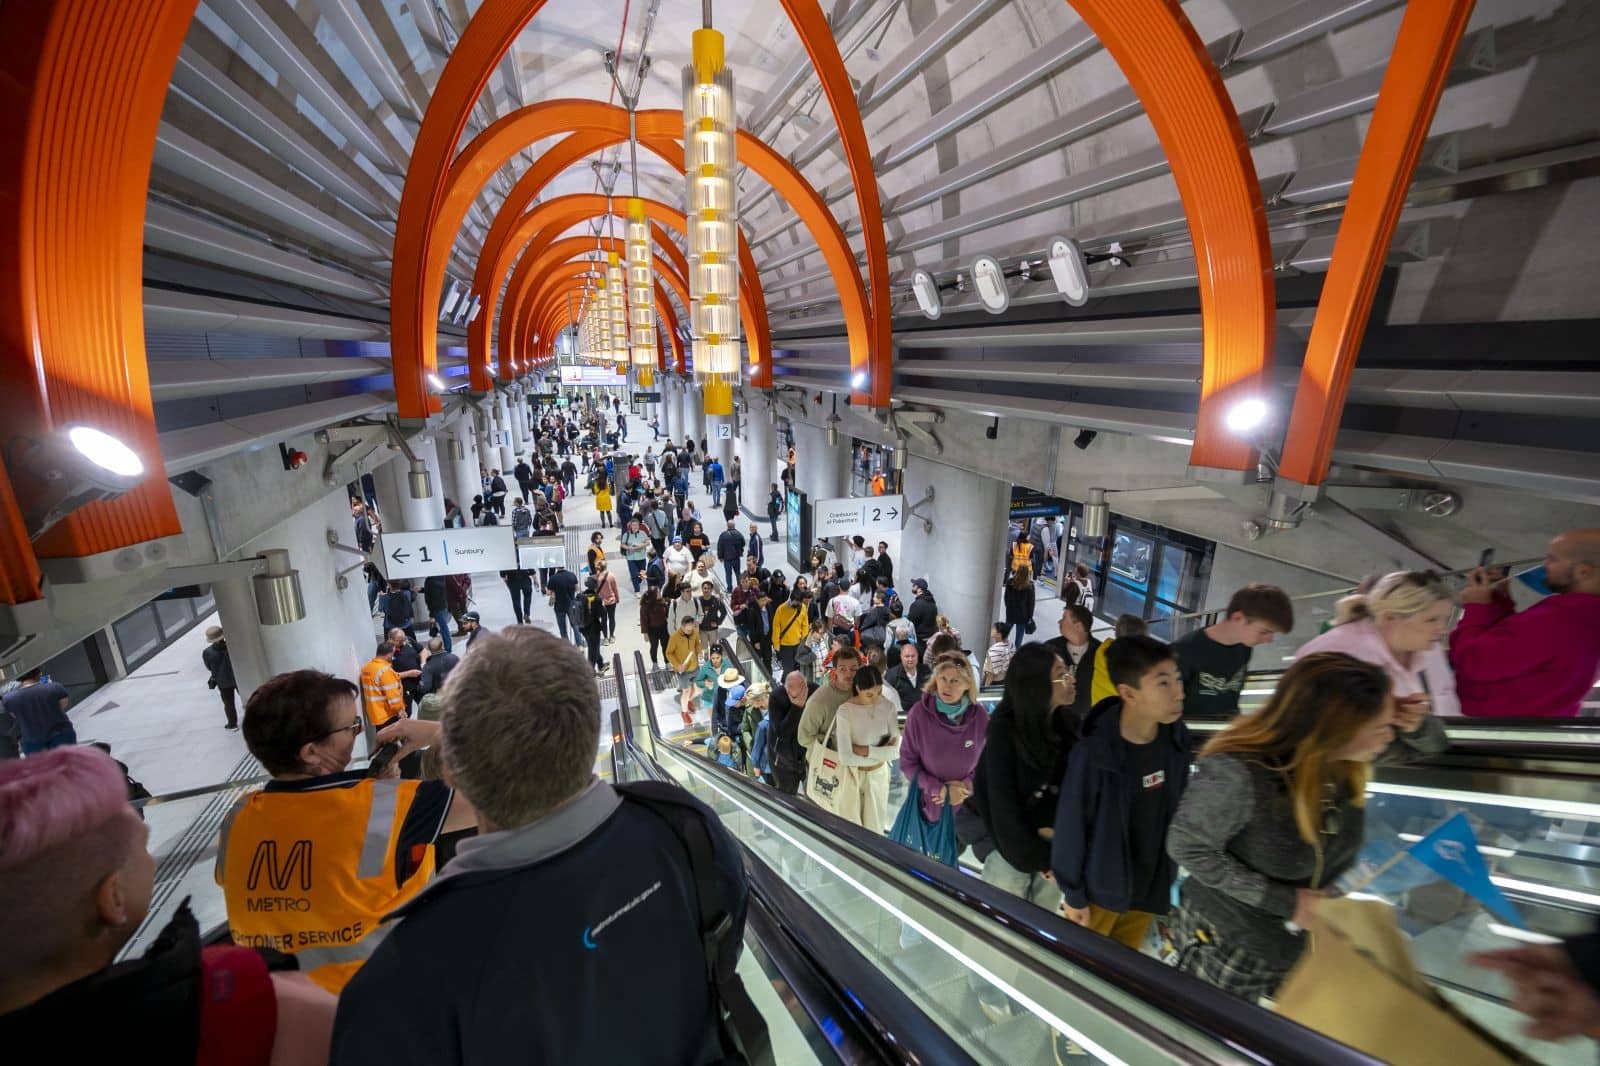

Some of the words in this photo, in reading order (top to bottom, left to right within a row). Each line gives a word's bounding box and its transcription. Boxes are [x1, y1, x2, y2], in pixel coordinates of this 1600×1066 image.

[721, 426, 729, 437] 2
[495, 434, 502, 445] 1
[872, 508, 881, 521] 2
[419, 546, 432, 562] 1
[454, 548, 485, 556] Sunbury
[247, 897, 311, 913] METRO
[298, 921, 362, 945] SERVICE
